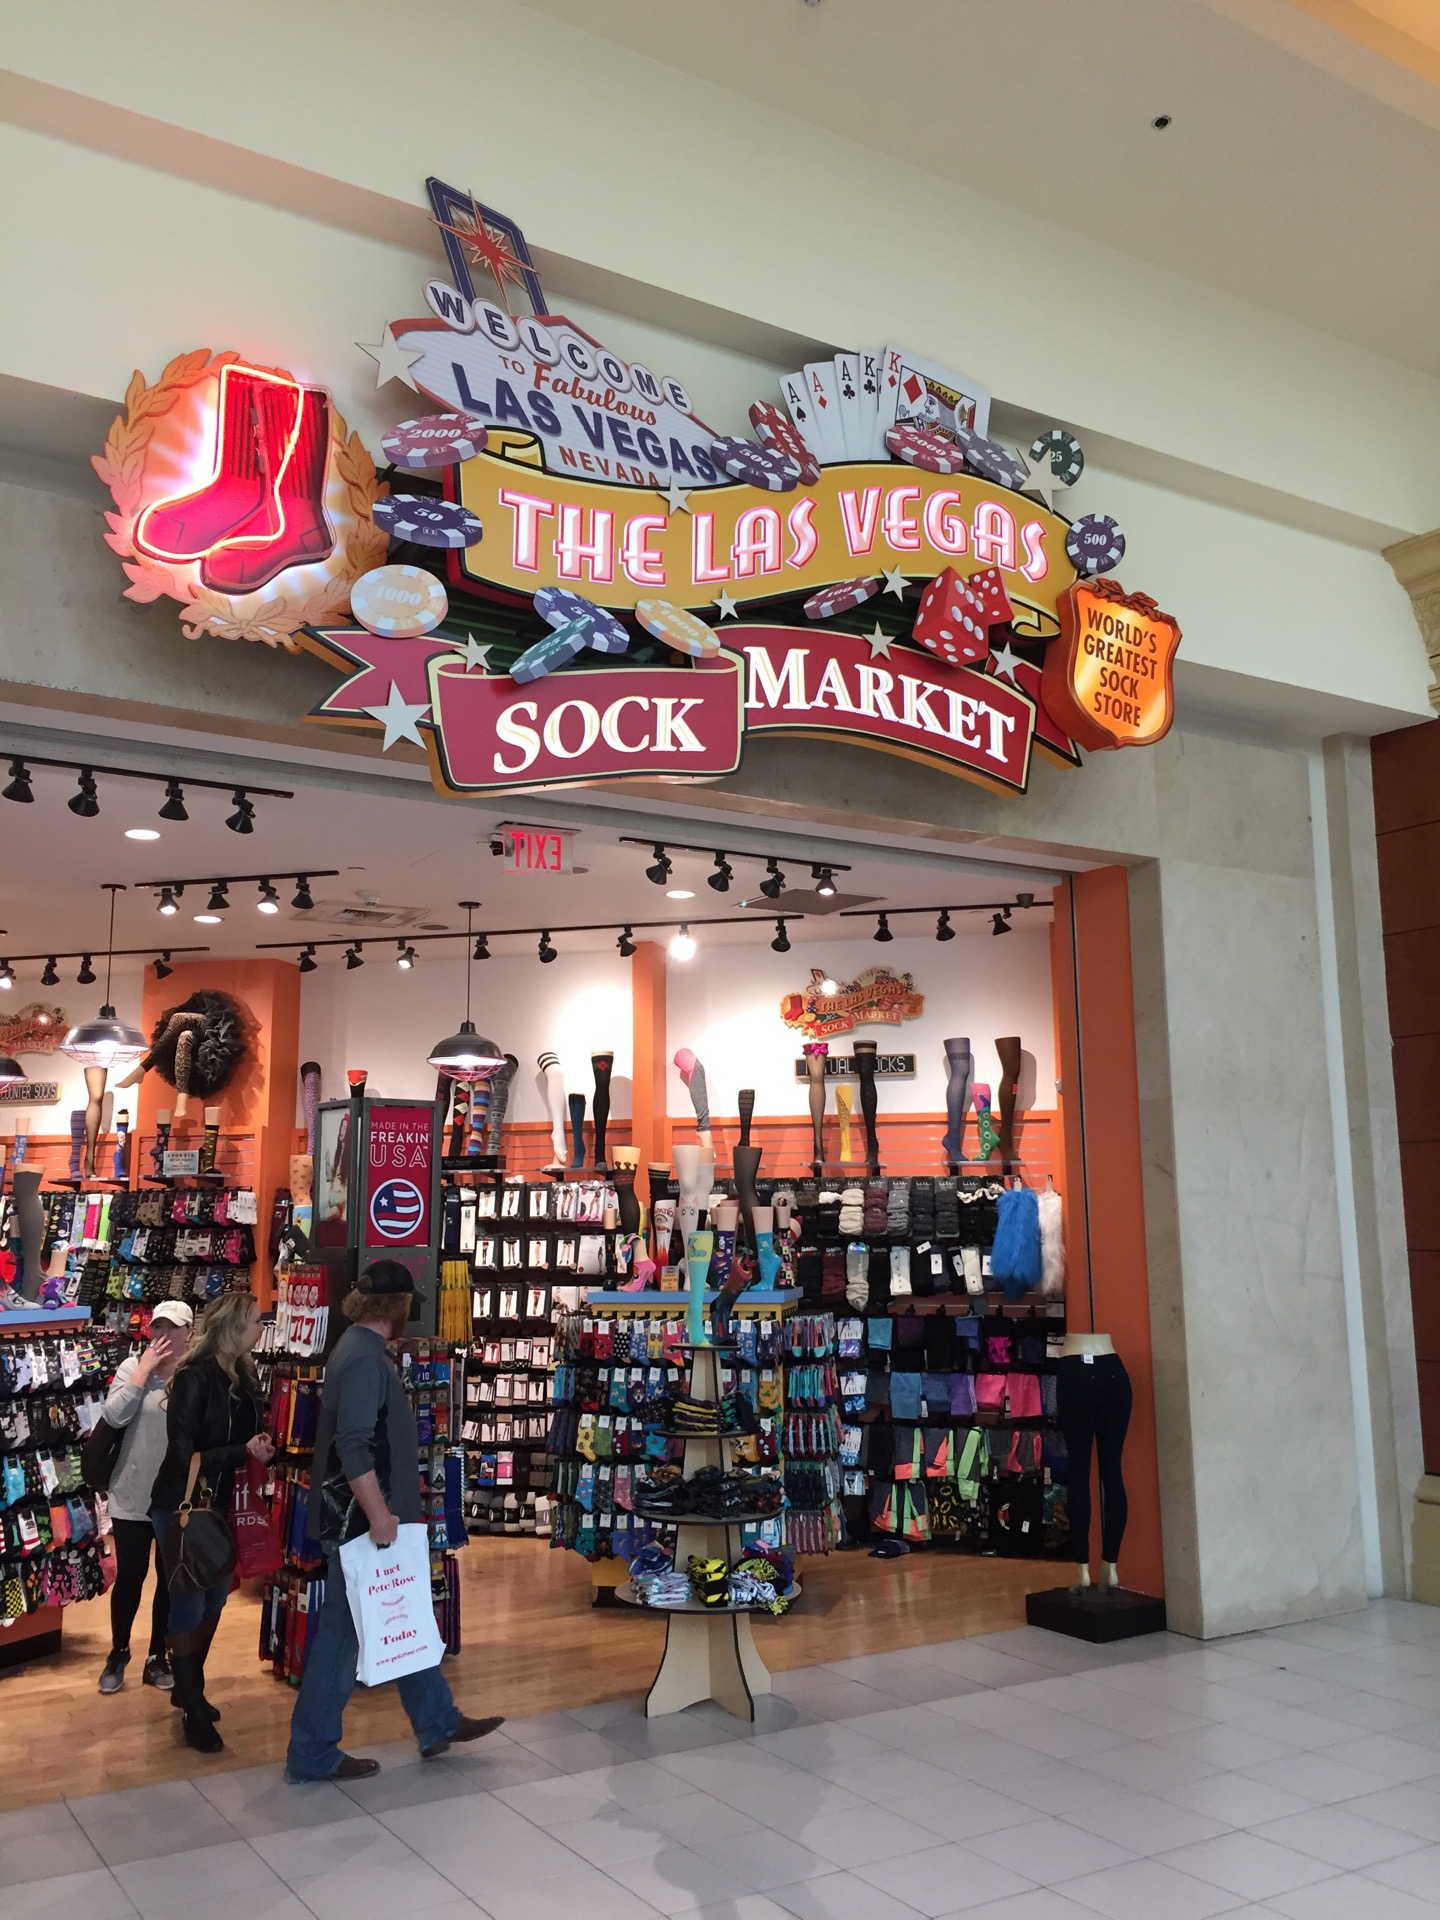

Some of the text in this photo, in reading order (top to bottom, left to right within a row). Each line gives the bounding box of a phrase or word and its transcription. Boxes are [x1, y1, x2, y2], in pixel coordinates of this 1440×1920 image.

[430, 283, 689, 408] WELCOME
[842, 360, 853, 382] A
[864, 356, 876, 377] K
[890, 351, 901, 374] K
[499, 355, 657, 426] TO Fabulous
[813, 371, 825, 392] A
[788, 382, 801, 404] A
[407, 428, 461, 439] 2000
[451, 362, 717, 483] LAS VEGAS
[776, 424, 800, 454] 100
[906, 433, 947, 456] 2000
[558, 445, 660, 487] NEVADA
[739, 448, 773, 469] 500
[1050, 451, 1063, 463] 25
[414, 507, 444, 522] 50
[497, 485, 1049, 588] THE LAS VEGAS
[1083, 532, 1107, 546] 500
[375, 585, 422, 606] 1000
[827, 586, 853, 598] 100
[661, 609, 699, 637] 1000
[1086, 605, 1157, 655] WORLD'S
[1083, 634, 1158, 681] GREATEST
[1099, 667, 1139, 700] SOCK
[492, 644, 1017, 775] SOCK MARKET
[1093, 691, 1142, 729] STORE
[821, 1010, 899, 1036] SOCK MARKET
[874, 1056, 906, 1073] OCKS
[371, 1121, 429, 1131] MADE IN THE
[370, 1144, 428, 1168] USA
[232, 1482, 250, 1512] if
[236, 1515, 266, 1527] RDS
[375, 1563, 401, 1578] I met
[368, 1575, 416, 1596] Pete Rose
[380, 1629, 418, 1646] Today
